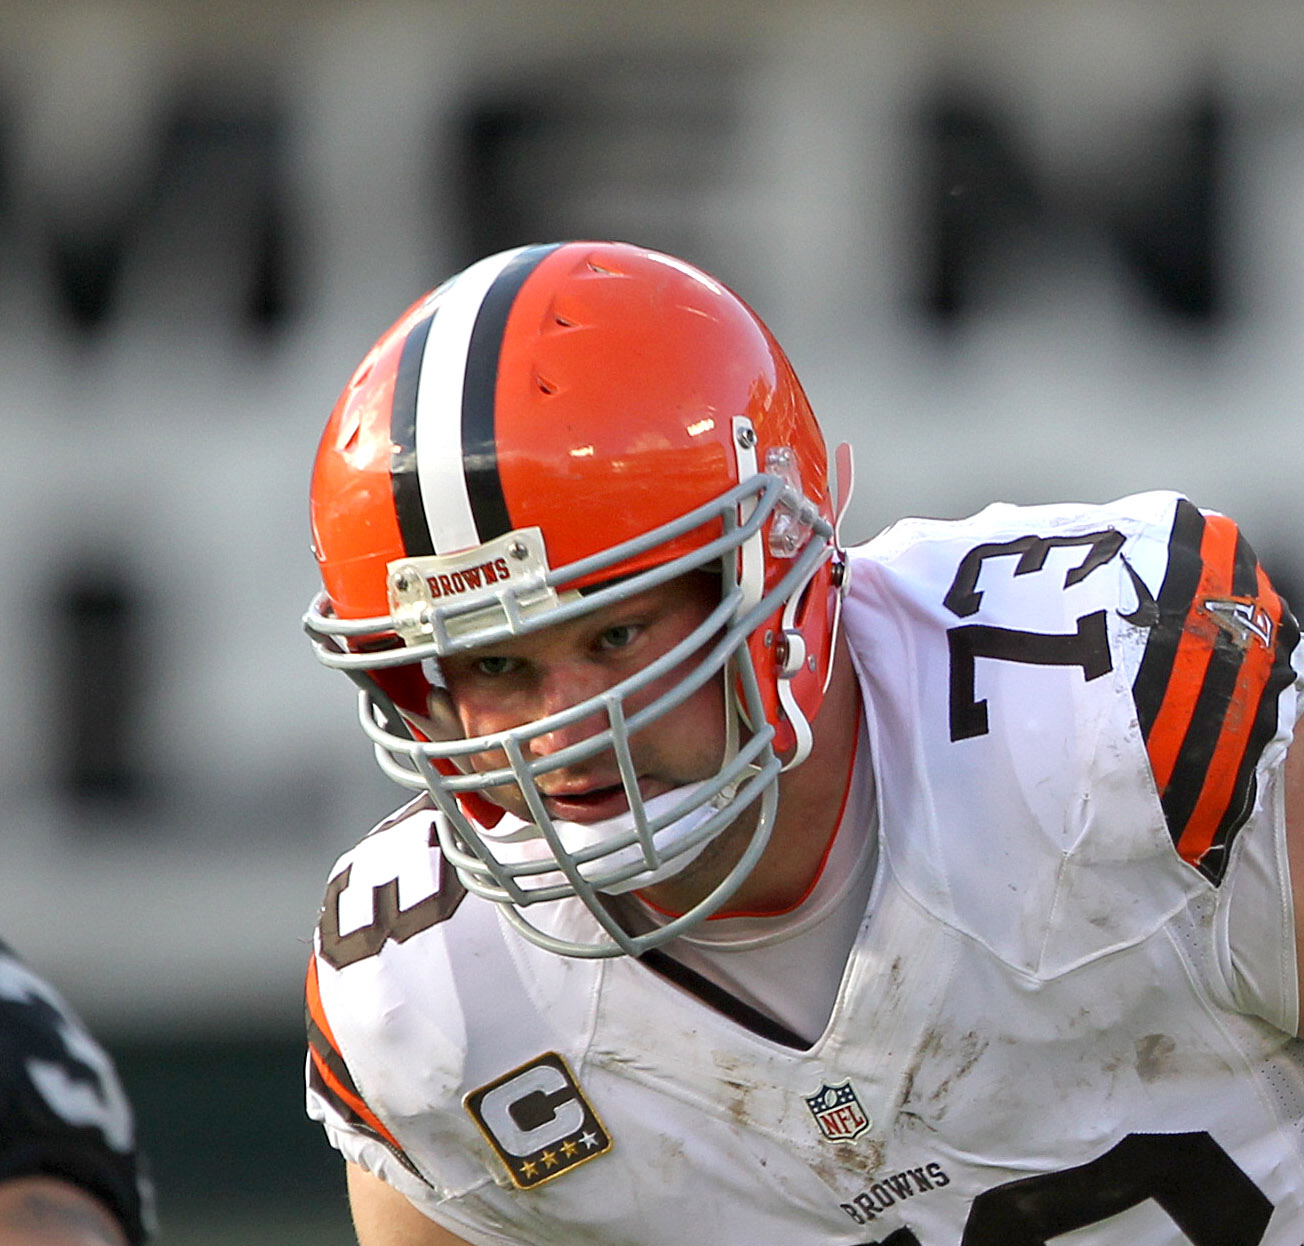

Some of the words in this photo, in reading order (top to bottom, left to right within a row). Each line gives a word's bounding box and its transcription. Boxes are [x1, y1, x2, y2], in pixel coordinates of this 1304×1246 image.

[426, 558, 510, 598] BROWNS
[943, 526, 1128, 744] 73
[480, 1065, 585, 1157] C
[820, 1106, 864, 1136] NFL
[840, 1162, 950, 1225] BROWNS
